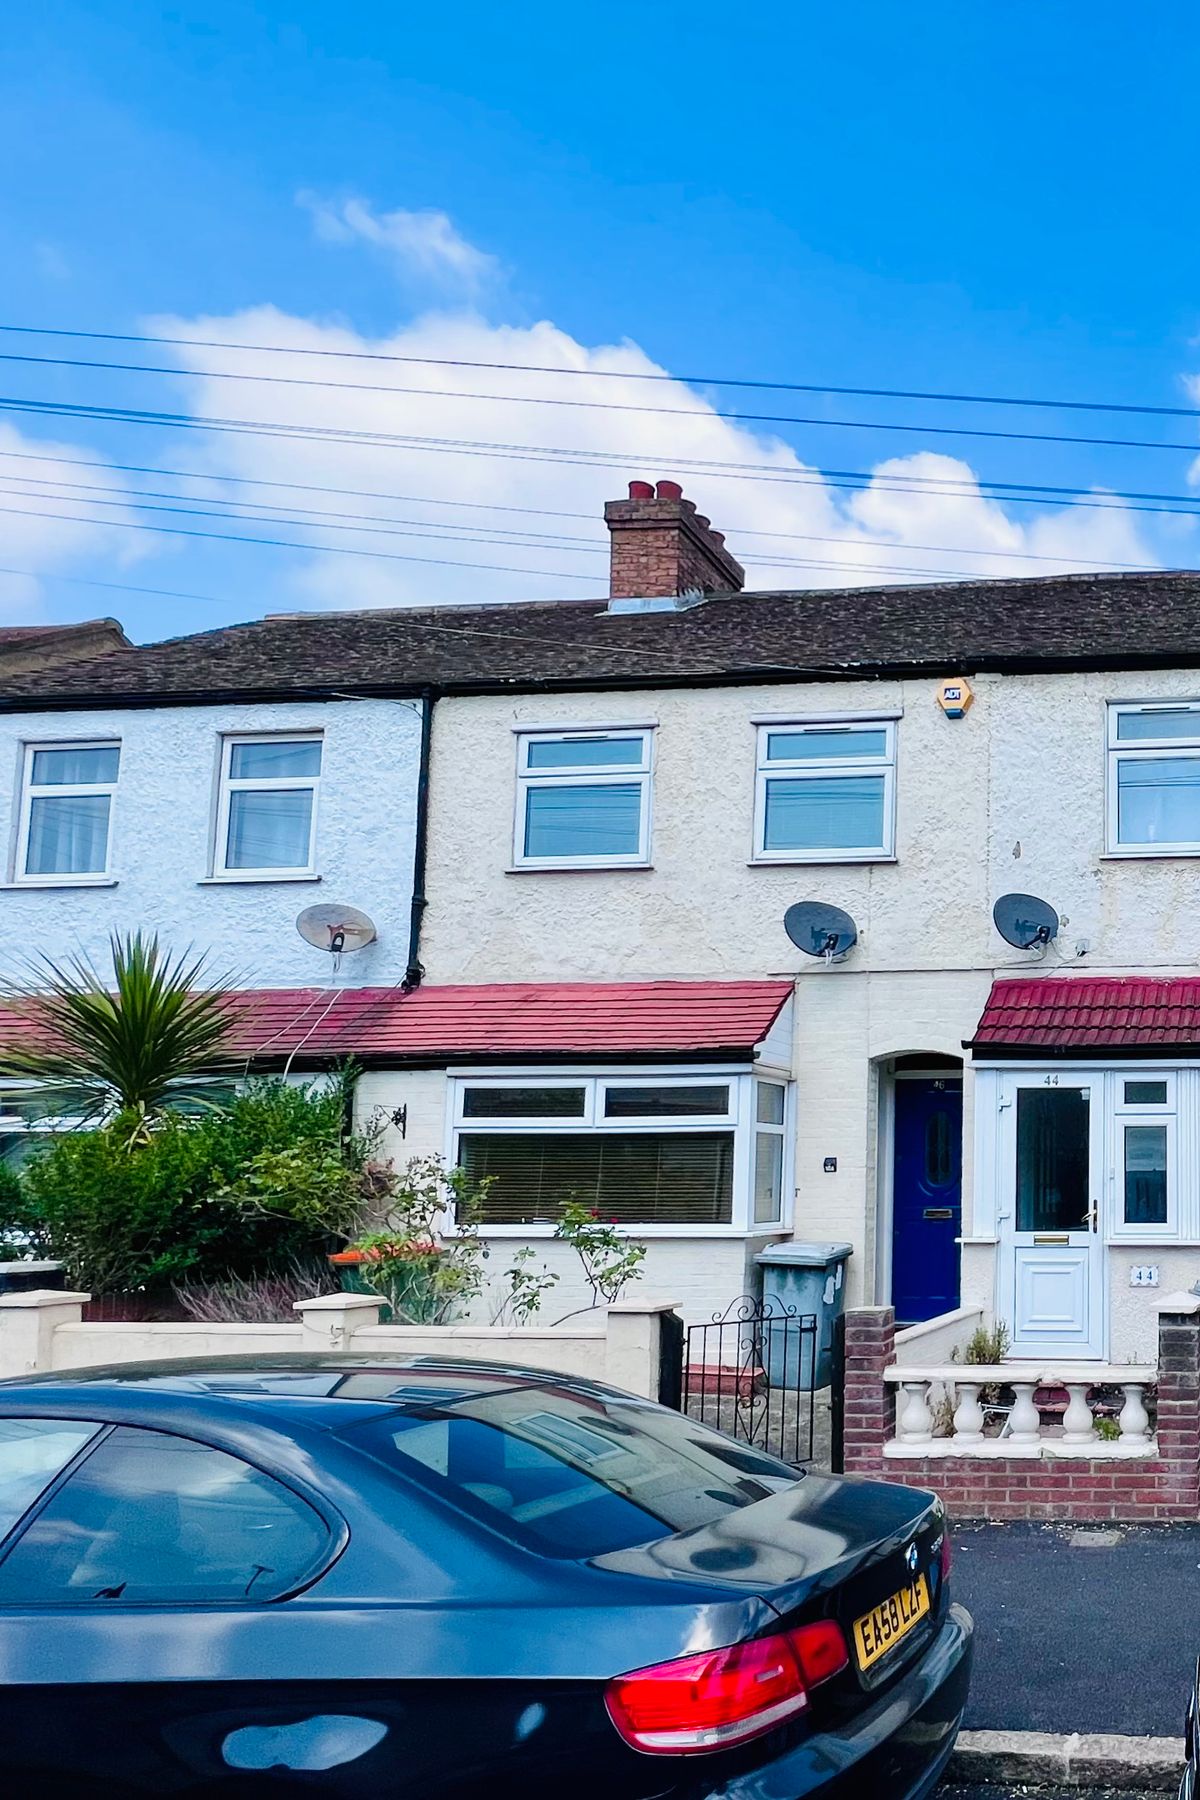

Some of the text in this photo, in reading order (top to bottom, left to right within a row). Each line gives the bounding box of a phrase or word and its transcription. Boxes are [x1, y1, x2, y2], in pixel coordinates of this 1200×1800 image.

[944, 688, 961, 699] ADT
[1044, 1075, 1059, 1085] 44
[1136, 1270, 1152, 1280] 44
[861, 1581, 921, 1658] EA58 LZF
